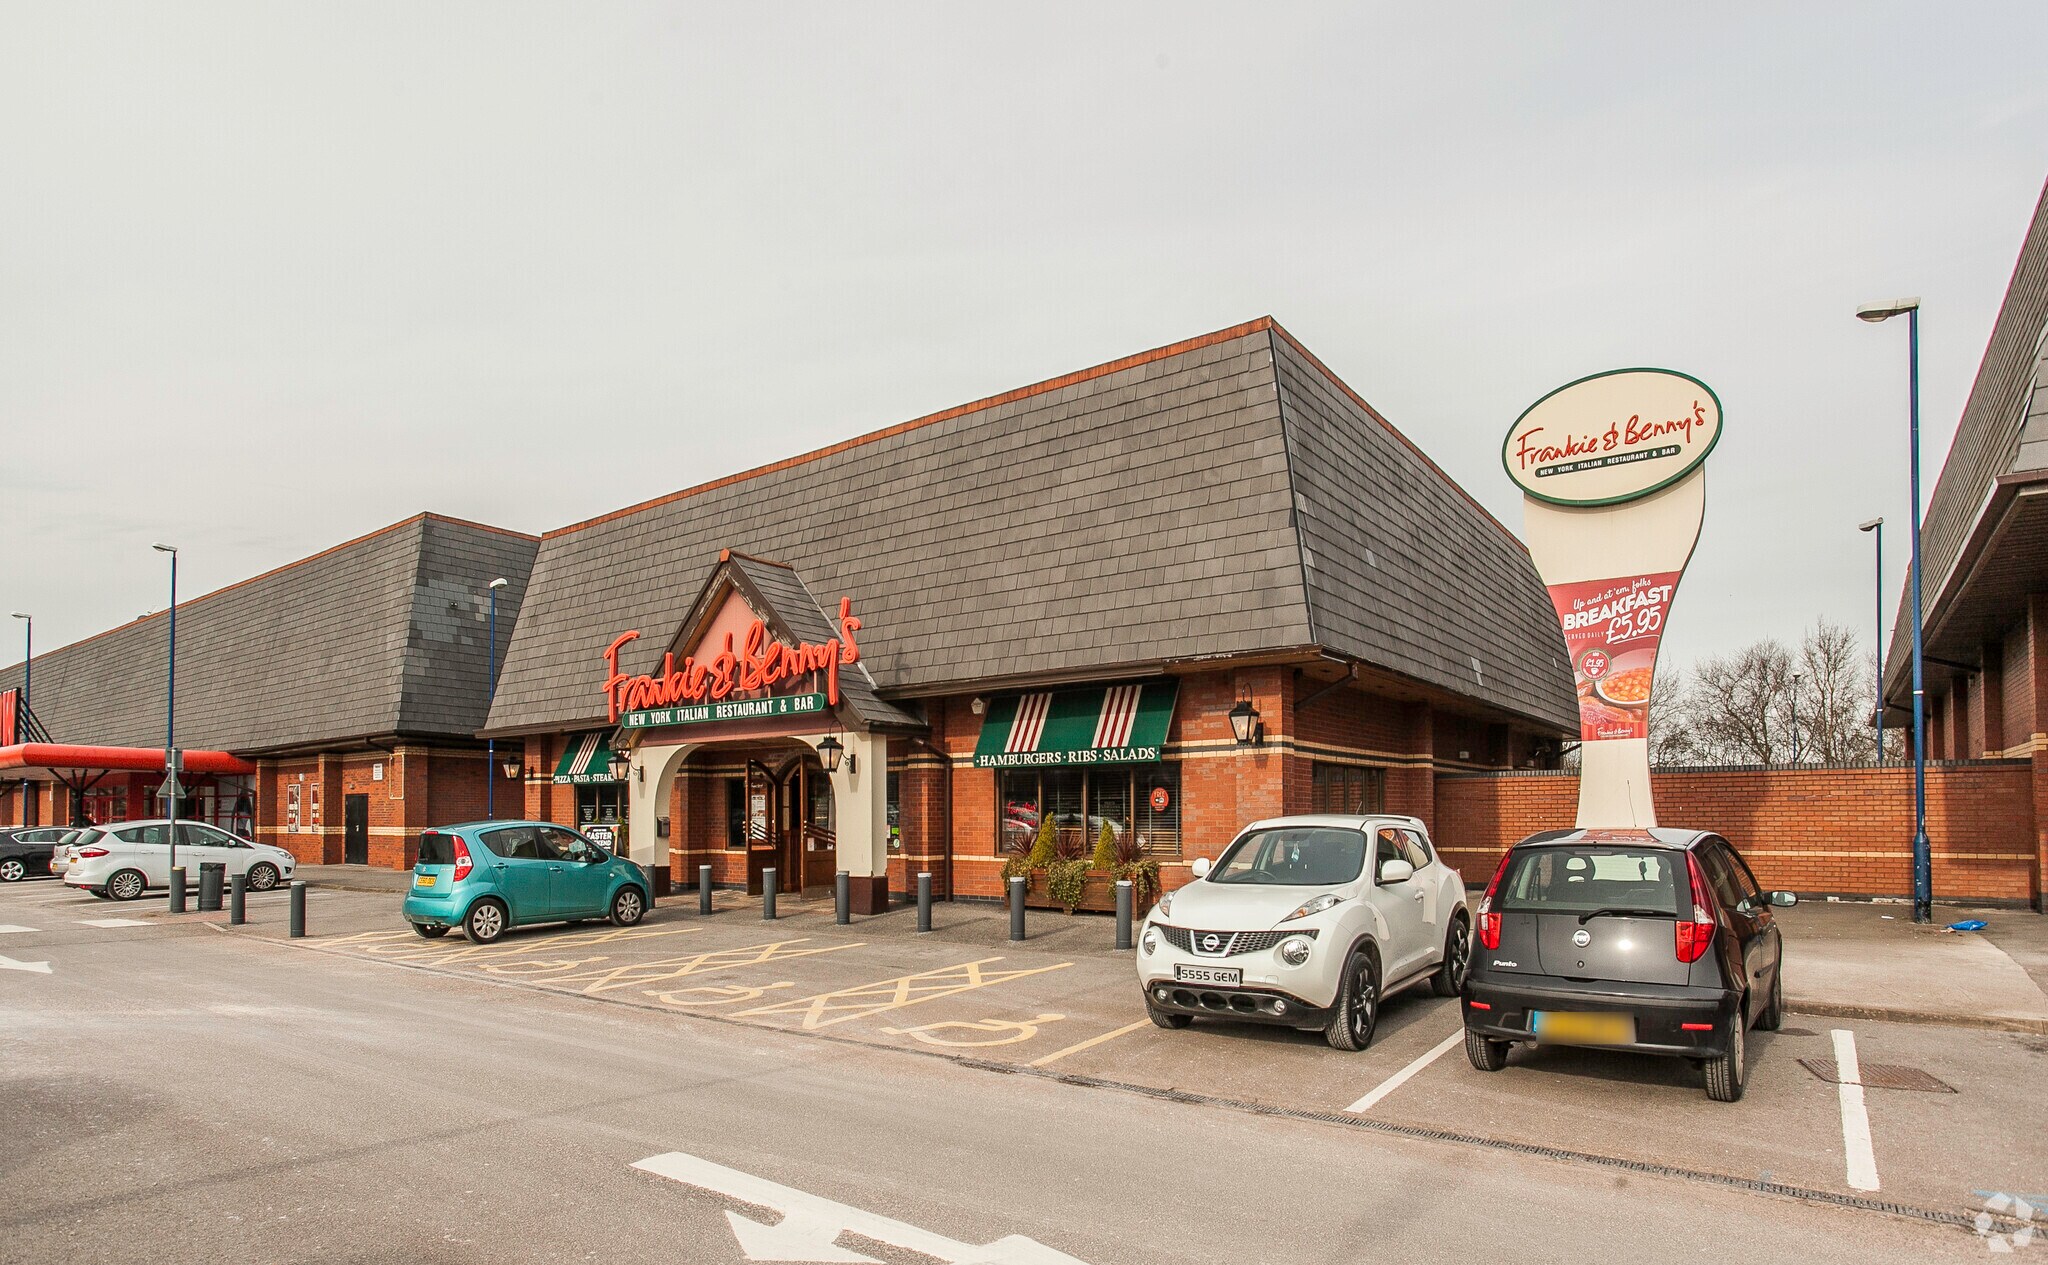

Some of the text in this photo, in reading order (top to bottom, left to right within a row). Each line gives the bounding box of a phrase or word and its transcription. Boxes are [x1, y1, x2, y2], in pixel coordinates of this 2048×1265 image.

[1516, 400, 1706, 470] Frankie & Benny's
[1540, 468, 1553, 476] NEW
[1557, 464, 1574, 473] YORK
[1577, 459, 1602, 470] ITALIAN
[1607, 451, 1648, 465] RESTAURANT
[1661, 447, 1676, 455] BAR
[1563, 585, 1672, 630] BREAKFAST
[1573, 598, 1586, 611] Up
[1586, 593, 1603, 605] and
[1603, 589, 1613, 599] at
[1631, 578, 1652, 594] folks
[1587, 631, 1604, 639] DAILY
[1605, 605, 1662, 644] £5.95
[603, 596, 862, 723] Frankie & Benny's
[628, 695, 814, 726] NEW YORK ITALIAN RESTAURANT & BAR
[979, 747, 1156, 767] HAMBURGERS RIBS SALADS
[554, 773, 615, 784] PIZZA PASTA STEAK
[1213, 972, 1238, 983] GEM
[1493, 959, 1518, 967] Punto
